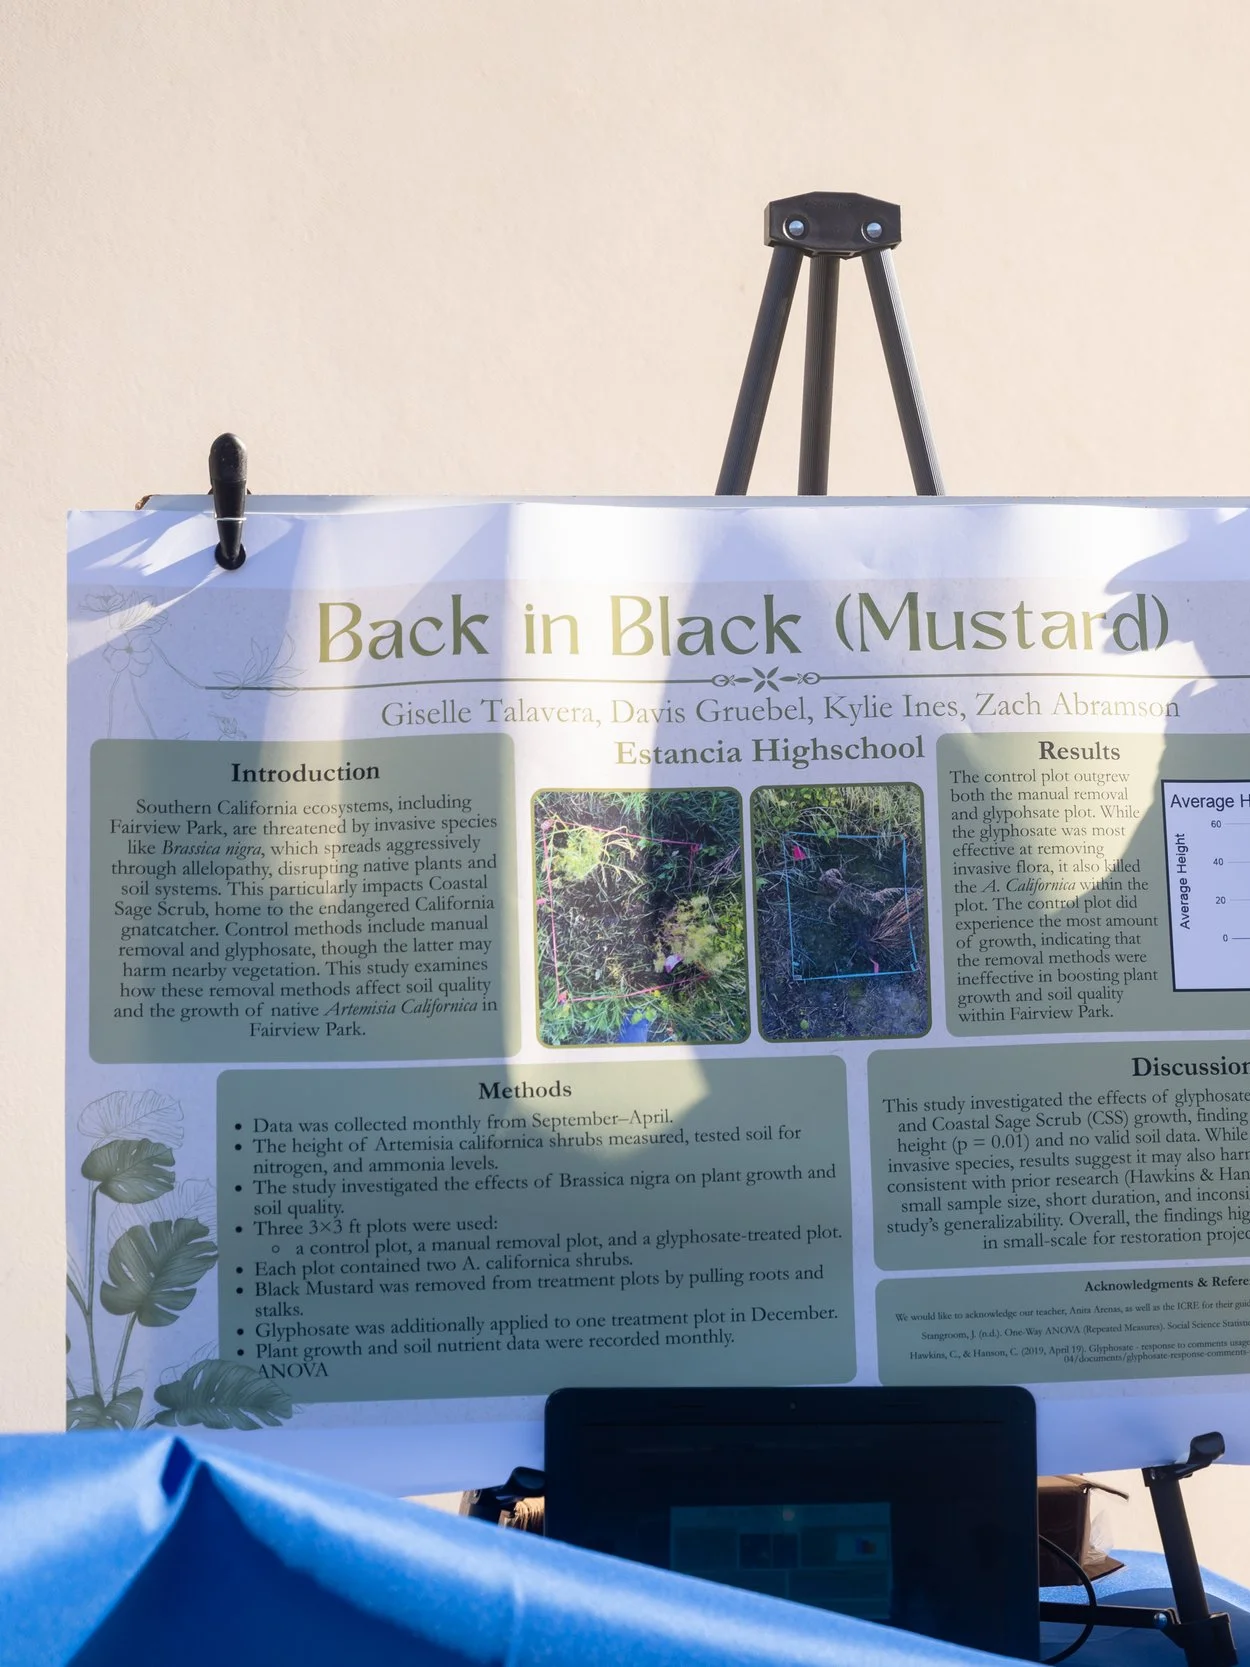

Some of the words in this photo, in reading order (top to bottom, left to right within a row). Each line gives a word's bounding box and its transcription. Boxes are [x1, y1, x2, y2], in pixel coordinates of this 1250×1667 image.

[318, 594, 490, 663] Back
[523, 603, 580, 655] in
[610, 593, 802, 657] Black
[834, 591, 1169, 652] (Mustard)
[381, 699, 472, 727] Giselle
[480, 697, 603, 728] Talavera,
[610, 699, 686, 724] Davis
[695, 697, 814, 726] Gruebel,
[822, 694, 893, 727] Kylie
[903, 693, 967, 721] Ines,
[975, 692, 1042, 717] Zach
[1052, 692, 1181, 719] Abramson
[614, 739, 743, 766] Estancia
[751, 735, 926, 770] Highschool
[1037, 740, 1121, 761] Results
[231, 761, 381, 783] Introduction
[949, 770, 980, 783] The
[983, 768, 1037, 783] control
[1041, 769, 1069, 786] plot
[1073, 772, 1128, 786] outgrew
[949, 788, 985, 802] both
[989, 788, 1013, 801] the
[1017, 786, 1069, 801] manual
[1073, 787, 1128, 801] removal
[1170, 793, 1235, 812] Average
[136, 797, 212, 817] Southern
[217, 798, 298, 817] California
[303, 802, 393, 819] ecosystems,
[397, 793, 473, 812] including
[951, 807, 979, 820] and
[1063, 805, 1096, 822] plot.
[1100, 805, 1140, 818] While
[110, 817, 181, 836] Fairview
[185, 818, 228, 839] Park,
[232, 825, 257, 835] are
[262, 818, 347, 836] threatened
[351, 818, 371, 837] by
[374, 815, 436, 832] invasive
[441, 817, 498, 837] species
[951, 825, 976, 838] the
[979, 822, 1057, 843] glyphosate
[1061, 828, 1087, 836] was
[1210, 820, 1222, 829] 60
[127, 839, 156, 855] like
[160, 838, 221, 857] Brassica
[225, 840, 266, 861] nigra,
[269, 840, 318, 856] which
[324, 837, 381, 859] spreads
[385, 835, 482, 857] aggressively
[952, 841, 1016, 857] effective
[1019, 845, 1033, 855] at
[1037, 841, 1105, 859] removing
[1175, 833, 1189, 875] Height
[111, 860, 178, 878] through
[182, 859, 274, 881] allelopathy,
[277, 859, 359, 880] disrupting
[363, 860, 409, 873] native
[414, 854, 463, 876] plants
[467, 854, 497, 869] and
[1213, 858, 1224, 867] 40
[121, 881, 149, 895] soil
[154, 883, 222, 900] systems.
[226, 880, 265, 897] This
[269, 879, 359, 900] particularly
[362, 876, 424, 898] impacts
[428, 874, 489, 893] Coastal
[1179, 877, 1191, 930] Average
[1215, 896, 1226, 905] 20
[1222, 934, 1229, 942] 0
[249, 1020, 321, 1038] Fairview
[325, 1020, 366, 1037] Park.
[478, 1080, 573, 1101] Methods
[253, 1117, 294, 1134] Data
[297, 1122, 331, 1134] was
[333, 1115, 407, 1133] collected
[412, 1115, 481, 1136] monthly
[487, 1112, 527, 1130] from
[897, 1136, 947, 1157] height
[951, 1136, 968, 1155] (p
[991, 1133, 1030, 1153] 0.01)
[1035, 1132, 1065, 1147] and
[1069, 1136, 1090, 1145] no
[1093, 1129, 1131, 1146] valid
[1135, 1129, 1161, 1143] soil
[1165, 1127, 1201, 1143] data.
[1204, 1126, 1249, 1142] While
[252, 1219, 304, 1237] Three
[348, 1218, 362, 1233] ft
[366, 1217, 407, 1238] plots
[411, 1221, 451, 1233] were
[455, 1215, 498, 1231] used:
[983, 1235, 999, 1249] in
[1003, 1231, 1087, 1248] small-scale
[1093, 1230, 1117, 1244] for
[1120, 1228, 1203, 1244] restoration
[255, 1260, 297, 1277] Each
[301, 1260, 335, 1279] plot
[339, 1257, 421, 1274] contained
[426, 1261, 457, 1271] two
[461, 1256, 481, 1270] A.
[485, 1253, 571, 1270] californica
[575, 1250, 633, 1267] shrubs.
[1084, 1278, 1195, 1293] Acknowledgments
[1196, 1276, 1209, 1288] &
[1045, 1325, 1081, 1335] ANOVA
[255, 1342, 299, 1359] Plant
[303, 1340, 363, 1362] growth
[367, 1339, 399, 1355] and
[403, 1338, 433, 1353] soil
[437, 1336, 502, 1353] nutrient
[506, 1334, 541, 1350] data
[544, 1338, 584, 1350] were
[588, 1330, 661, 1347] recorded
[665, 1328, 735, 1349] monthly.
[258, 1362, 329, 1379] ANOVA
